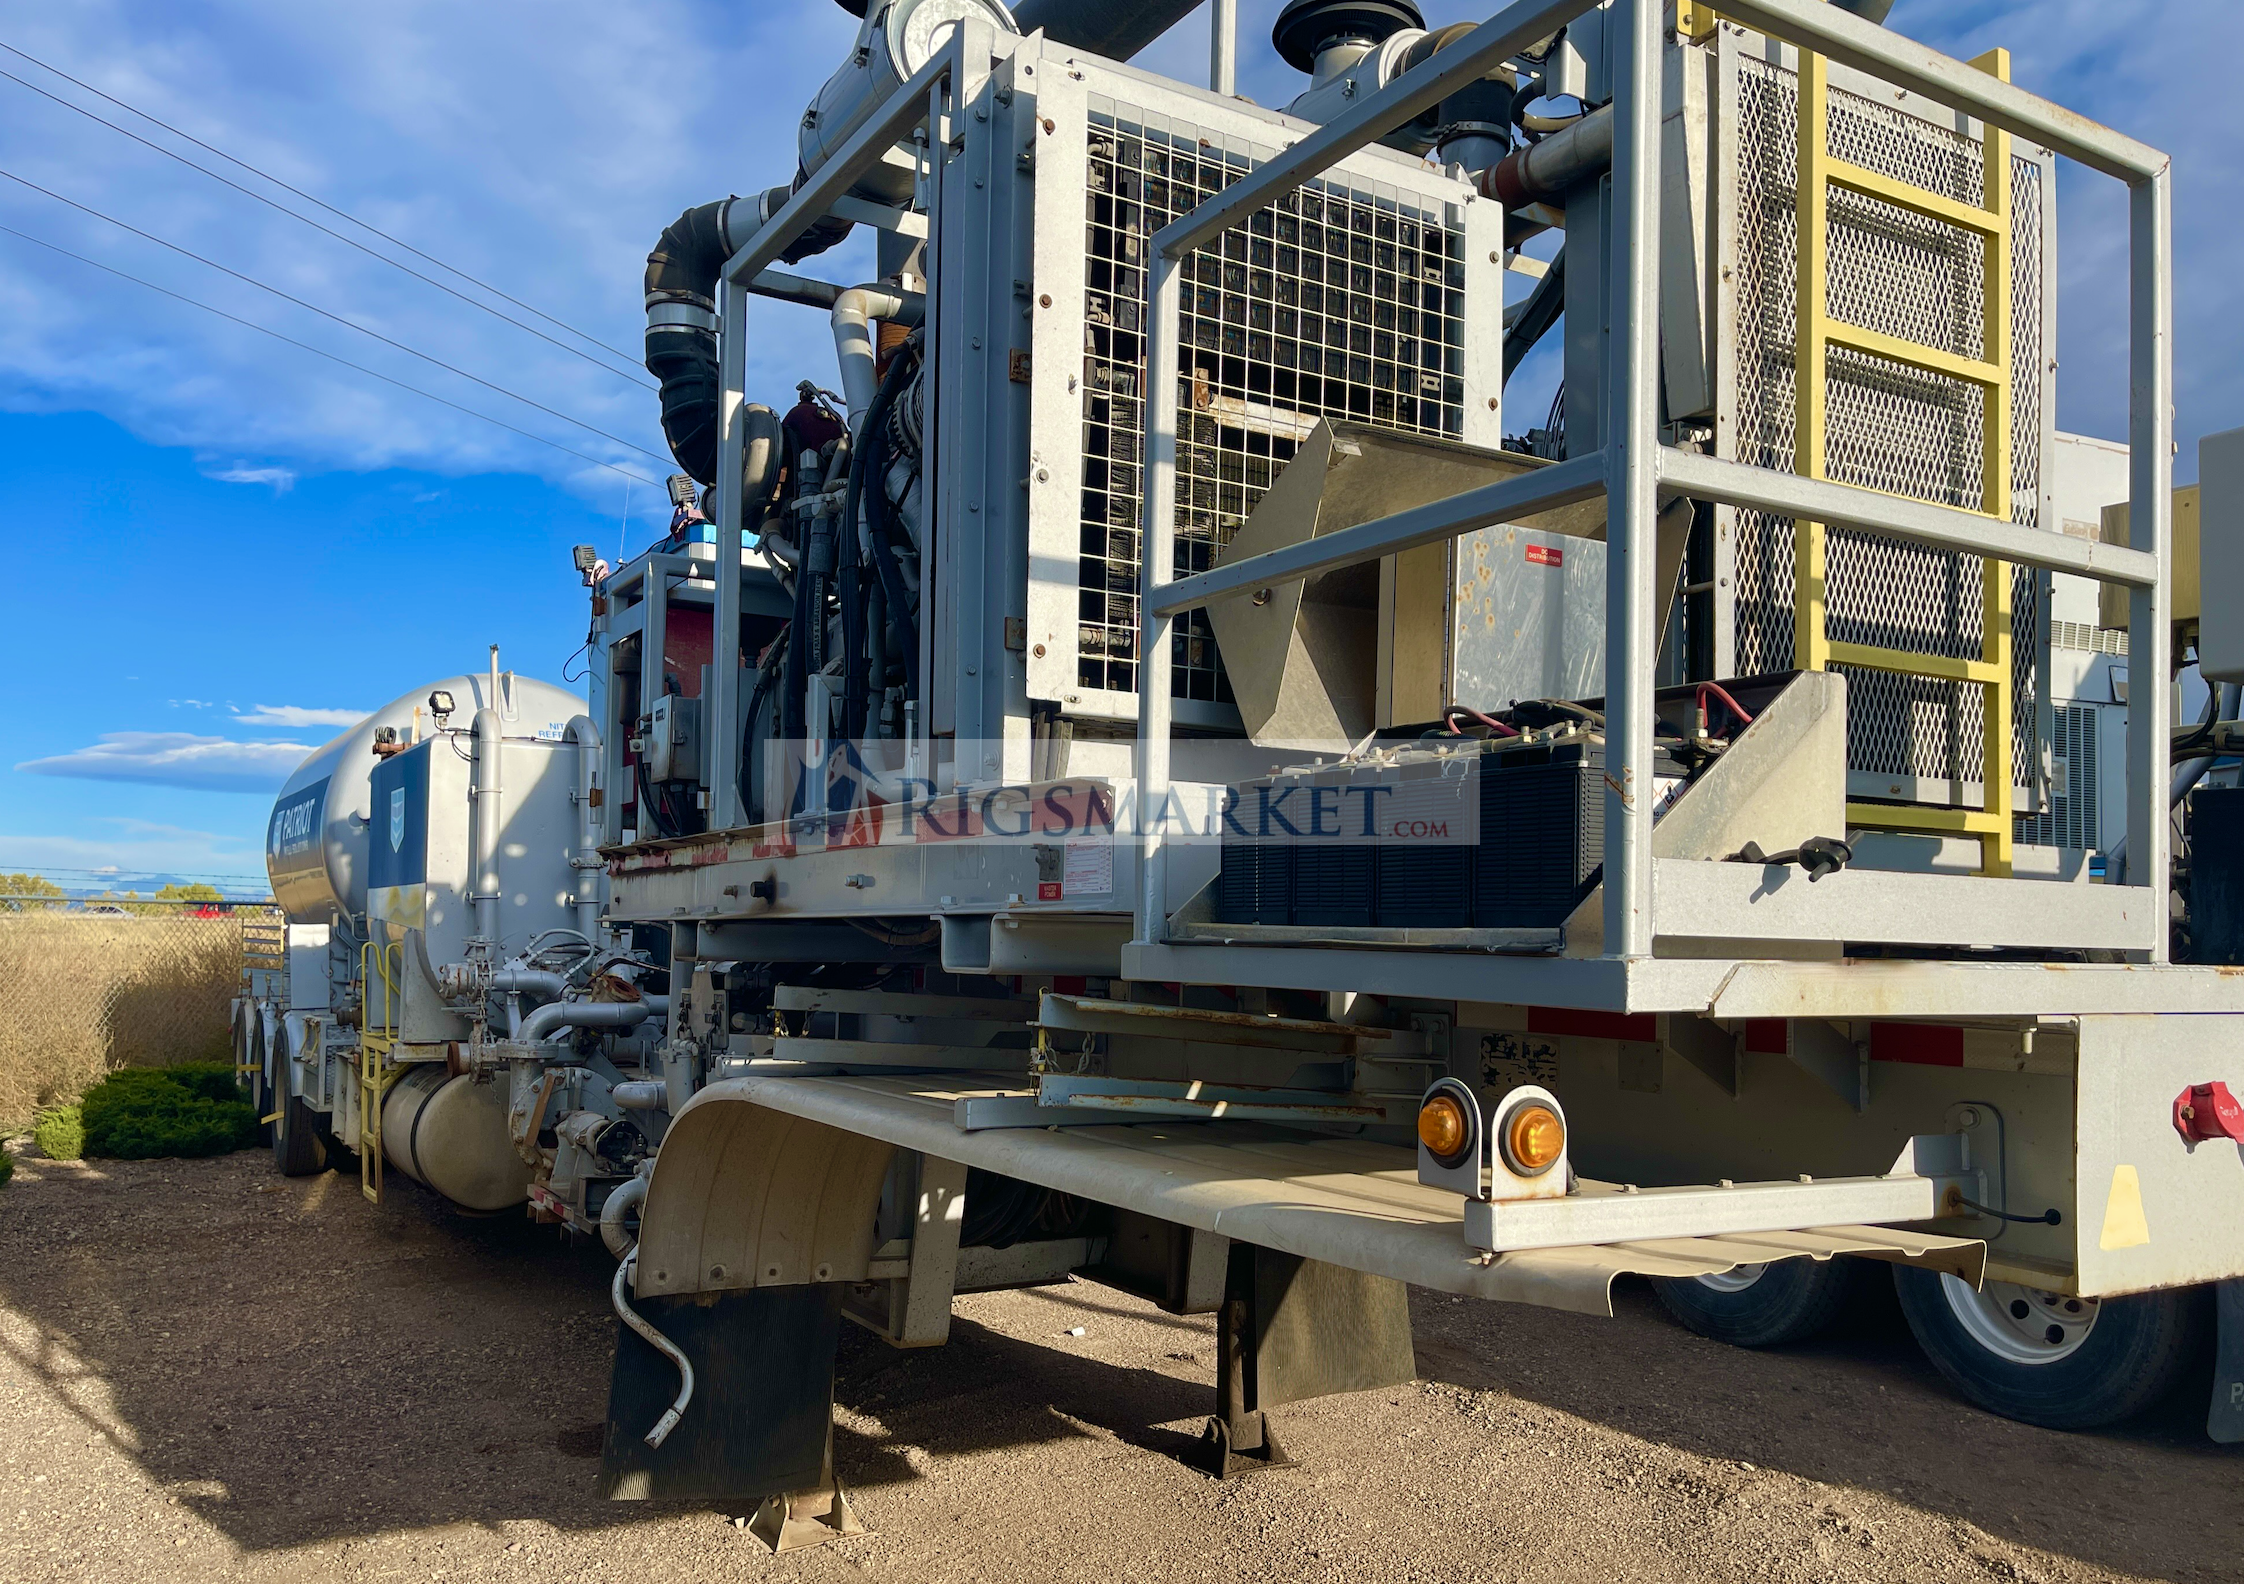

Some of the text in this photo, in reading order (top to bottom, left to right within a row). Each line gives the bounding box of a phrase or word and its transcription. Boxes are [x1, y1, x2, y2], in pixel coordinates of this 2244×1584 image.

[1528, 552, 1561, 563] DISTRIBUTION
[282, 798, 316, 840] PATRIOT
[2230, 1382, 2244, 1403] P
